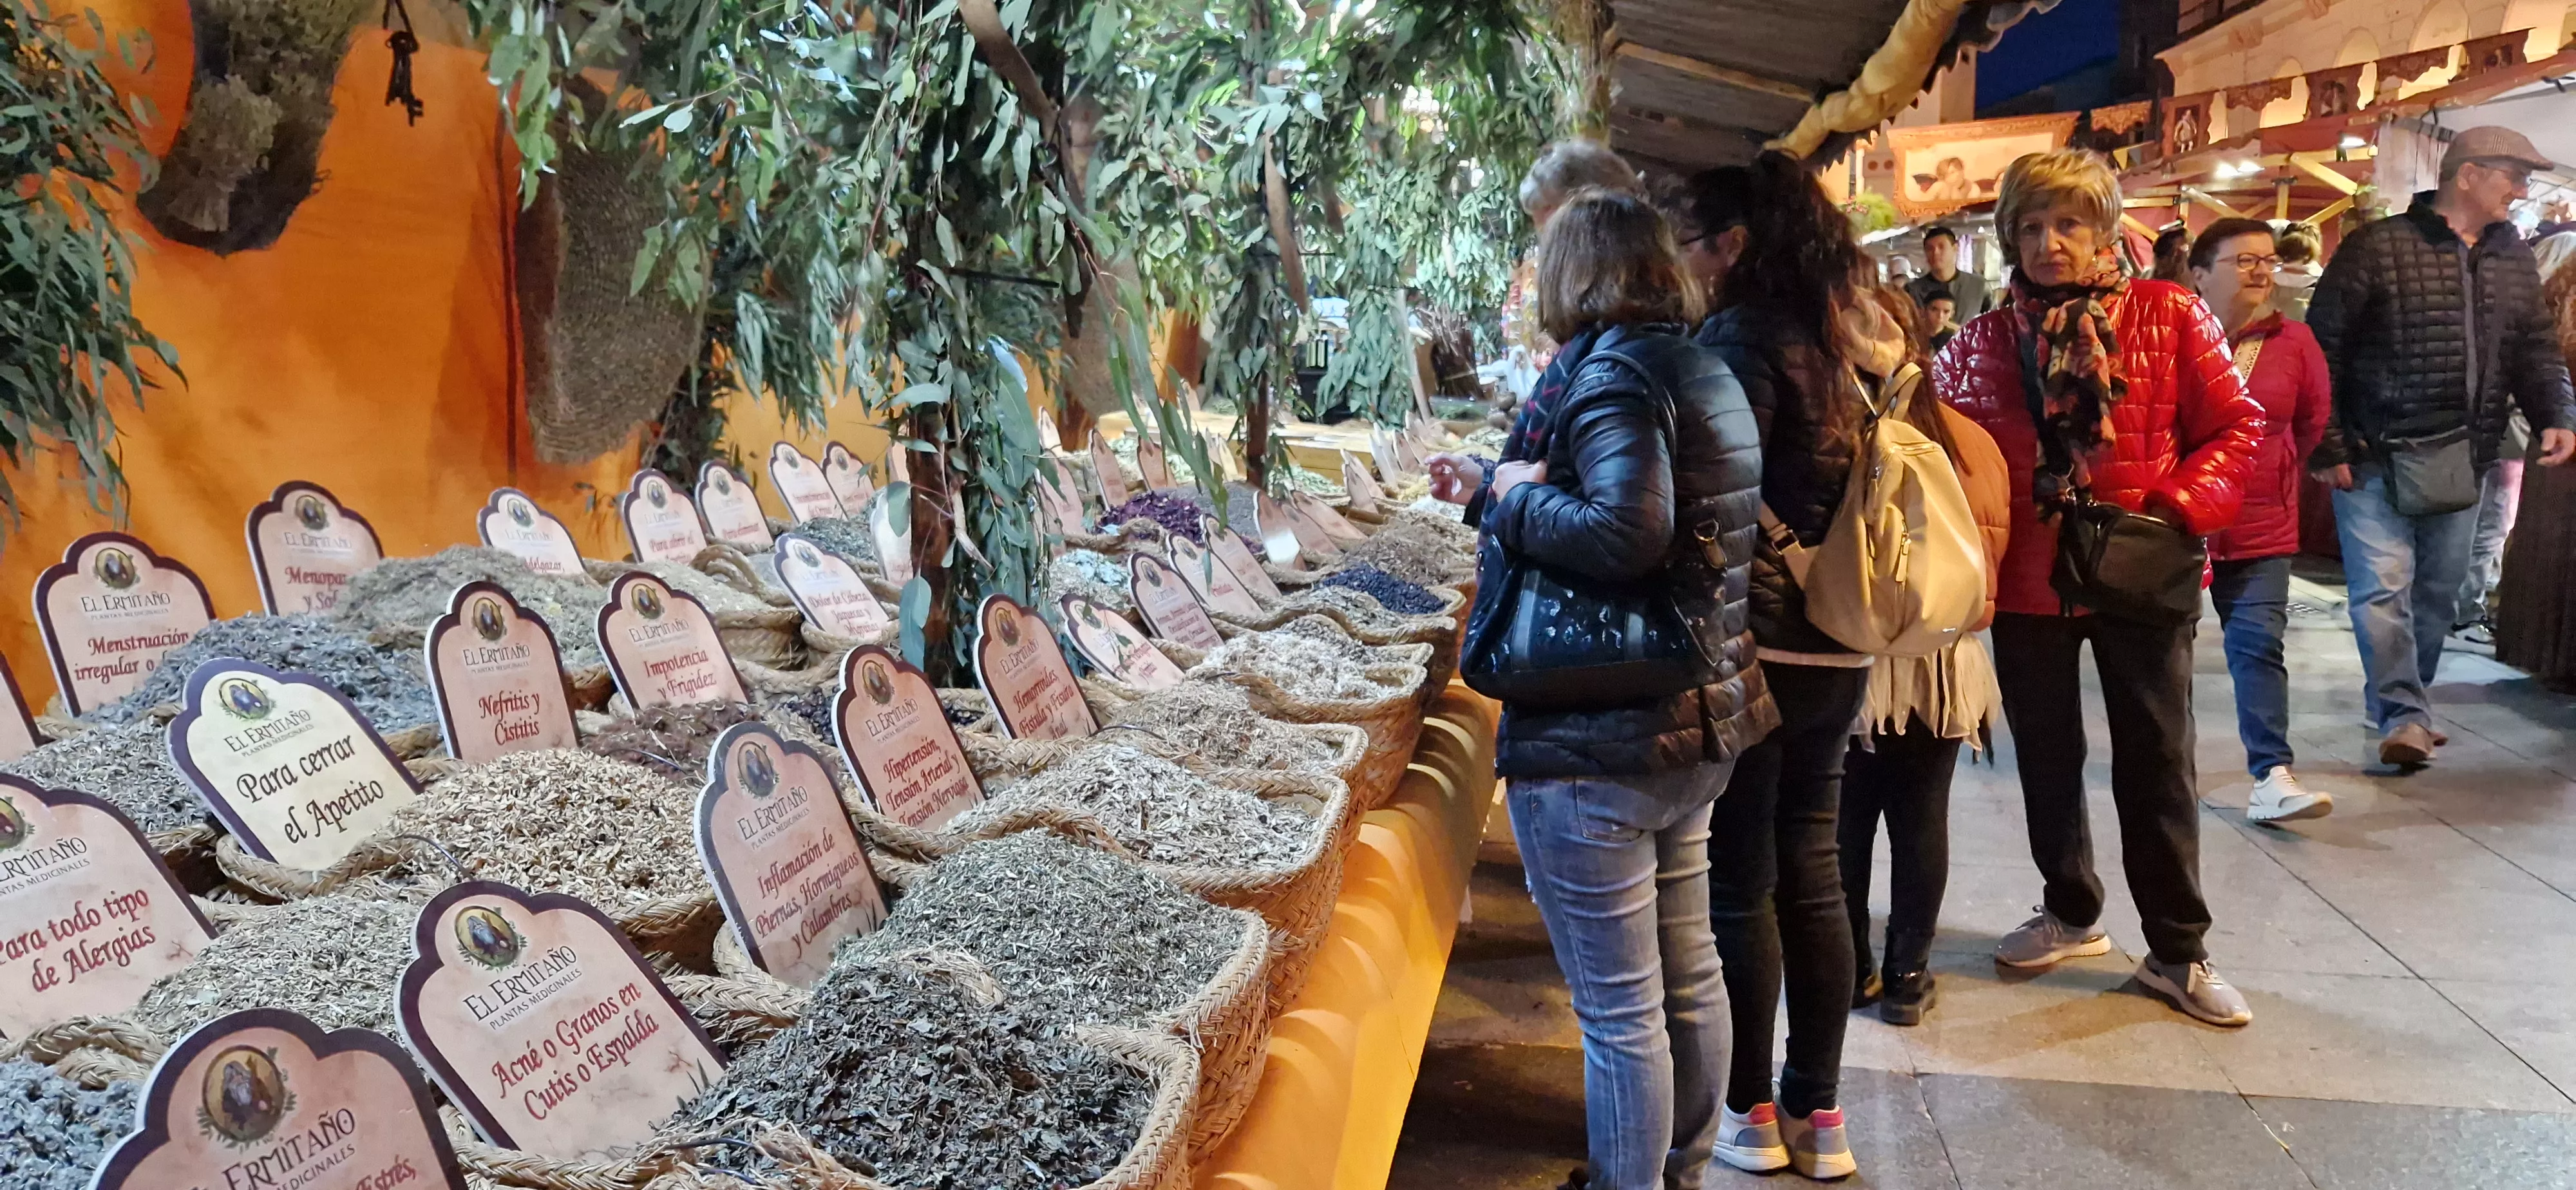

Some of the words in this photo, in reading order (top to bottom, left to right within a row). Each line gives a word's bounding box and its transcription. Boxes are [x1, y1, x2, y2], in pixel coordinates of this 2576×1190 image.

[80, 596, 101, 612] EL
[102, 590, 171, 610] ERMITAÑO
[88, 628, 189, 656] Menstruación
[629, 628, 644, 643] EL
[643, 618, 689, 639] ERMITAÑO
[74, 656, 140, 684] irregular
[146, 659, 155, 671] o
[462, 648, 479, 666] EL
[479, 643, 530, 664] ERMITAÑO
[643, 646, 708, 680] Impotencia
[478, 689, 530, 721] Nefritis
[531, 692, 540, 715] y
[667, 668, 717, 699] Frigidez
[223, 735, 248, 753] EL
[243, 709, 311, 743] ERMITAÑO
[495, 715, 540, 746] Cistitis
[865, 719, 881, 737] EL
[876, 698, 918, 730] ERMITAÑO
[1045, 703, 1054, 723] y
[242, 741, 272, 757] PLANTAS
[272, 724, 314, 746] MEDICINALES
[883, 736, 941, 783] Hipertensión,
[236, 764, 298, 804] Para
[299, 735, 355, 777] cerrar
[886, 777, 922, 812] Tensión
[920, 750, 953, 792] Arterial
[951, 753, 960, 774] y
[284, 806, 308, 844] el
[306, 780, 384, 838] Apetito
[737, 817, 759, 840] EL
[753, 786, 808, 830] ERMITAÑO
[751, 829, 776, 850] PLANTAS
[0, 882, 24, 897] NTAS
[26, 858, 90, 885] MEDICINALES
[757, 843, 822, 900] Inflamación
[823, 826, 835, 854] de
[755, 896, 804, 939] Piernas,
[800, 851, 859, 906] Hormigueos
[0, 929, 48, 964] ara
[48, 900, 101, 942] todo
[103, 889, 149, 923] tipo
[791, 934, 803, 959] y
[800, 892, 853, 945] Calambres
[32, 958, 61, 992] de
[63, 926, 156, 984] Alergias
[463, 994, 499, 1022] EL
[488, 945, 578, 1005] ERMITAÑO
[489, 1001, 529, 1030] PLANTAS
[529, 968, 582, 1005] MEDICINALES
[491, 1040, 544, 1099] Acné
[544, 1038, 558, 1059] o
[555, 996, 620, 1055] Granos
[620, 981, 642, 1007] en
[524, 1070, 578, 1120] Cutis
[577, 1063, 591, 1083] o
[585, 1009, 660, 1073] Espalda
